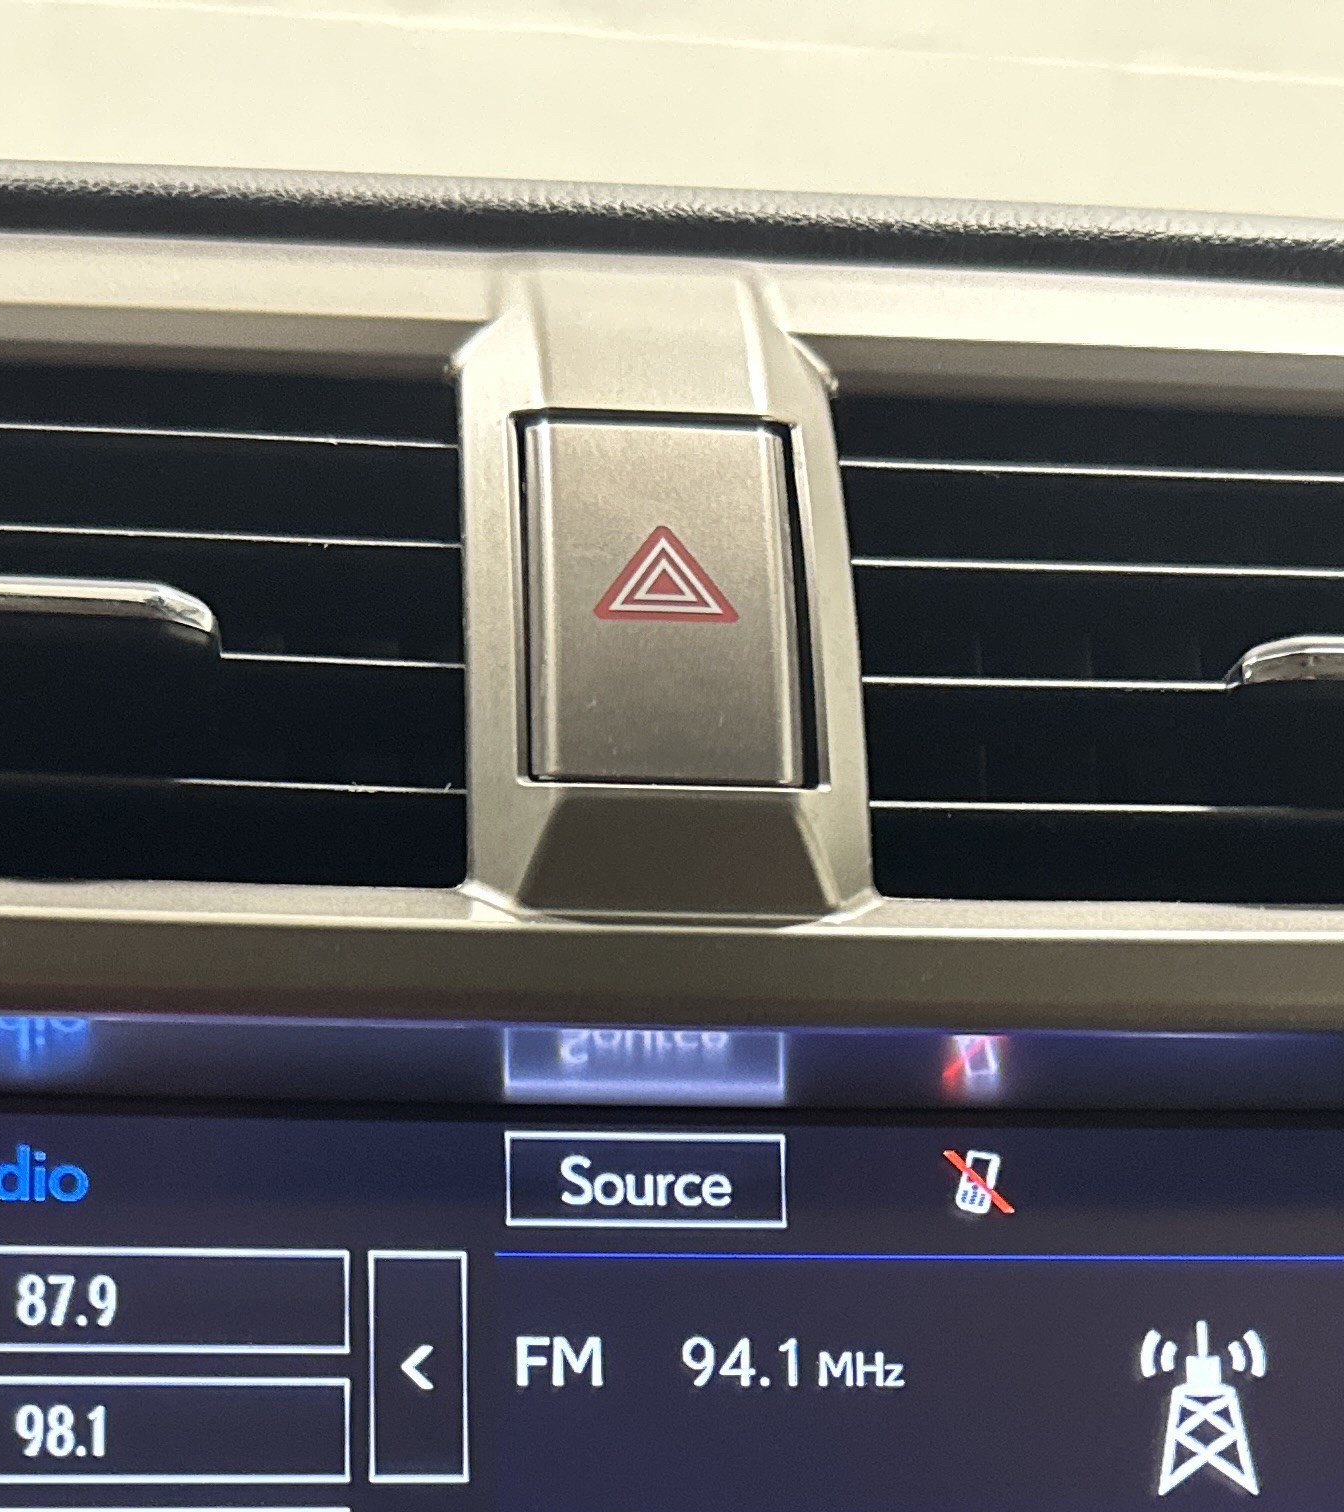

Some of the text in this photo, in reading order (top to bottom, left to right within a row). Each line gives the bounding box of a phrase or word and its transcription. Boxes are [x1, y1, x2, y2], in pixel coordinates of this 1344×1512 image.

[560, 1154, 733, 1208] Source
[15, 1272, 119, 1328] 87.9
[515, 1335, 907, 1388] FM 94.1 MHz
[14, 1403, 108, 1458] 98.1
